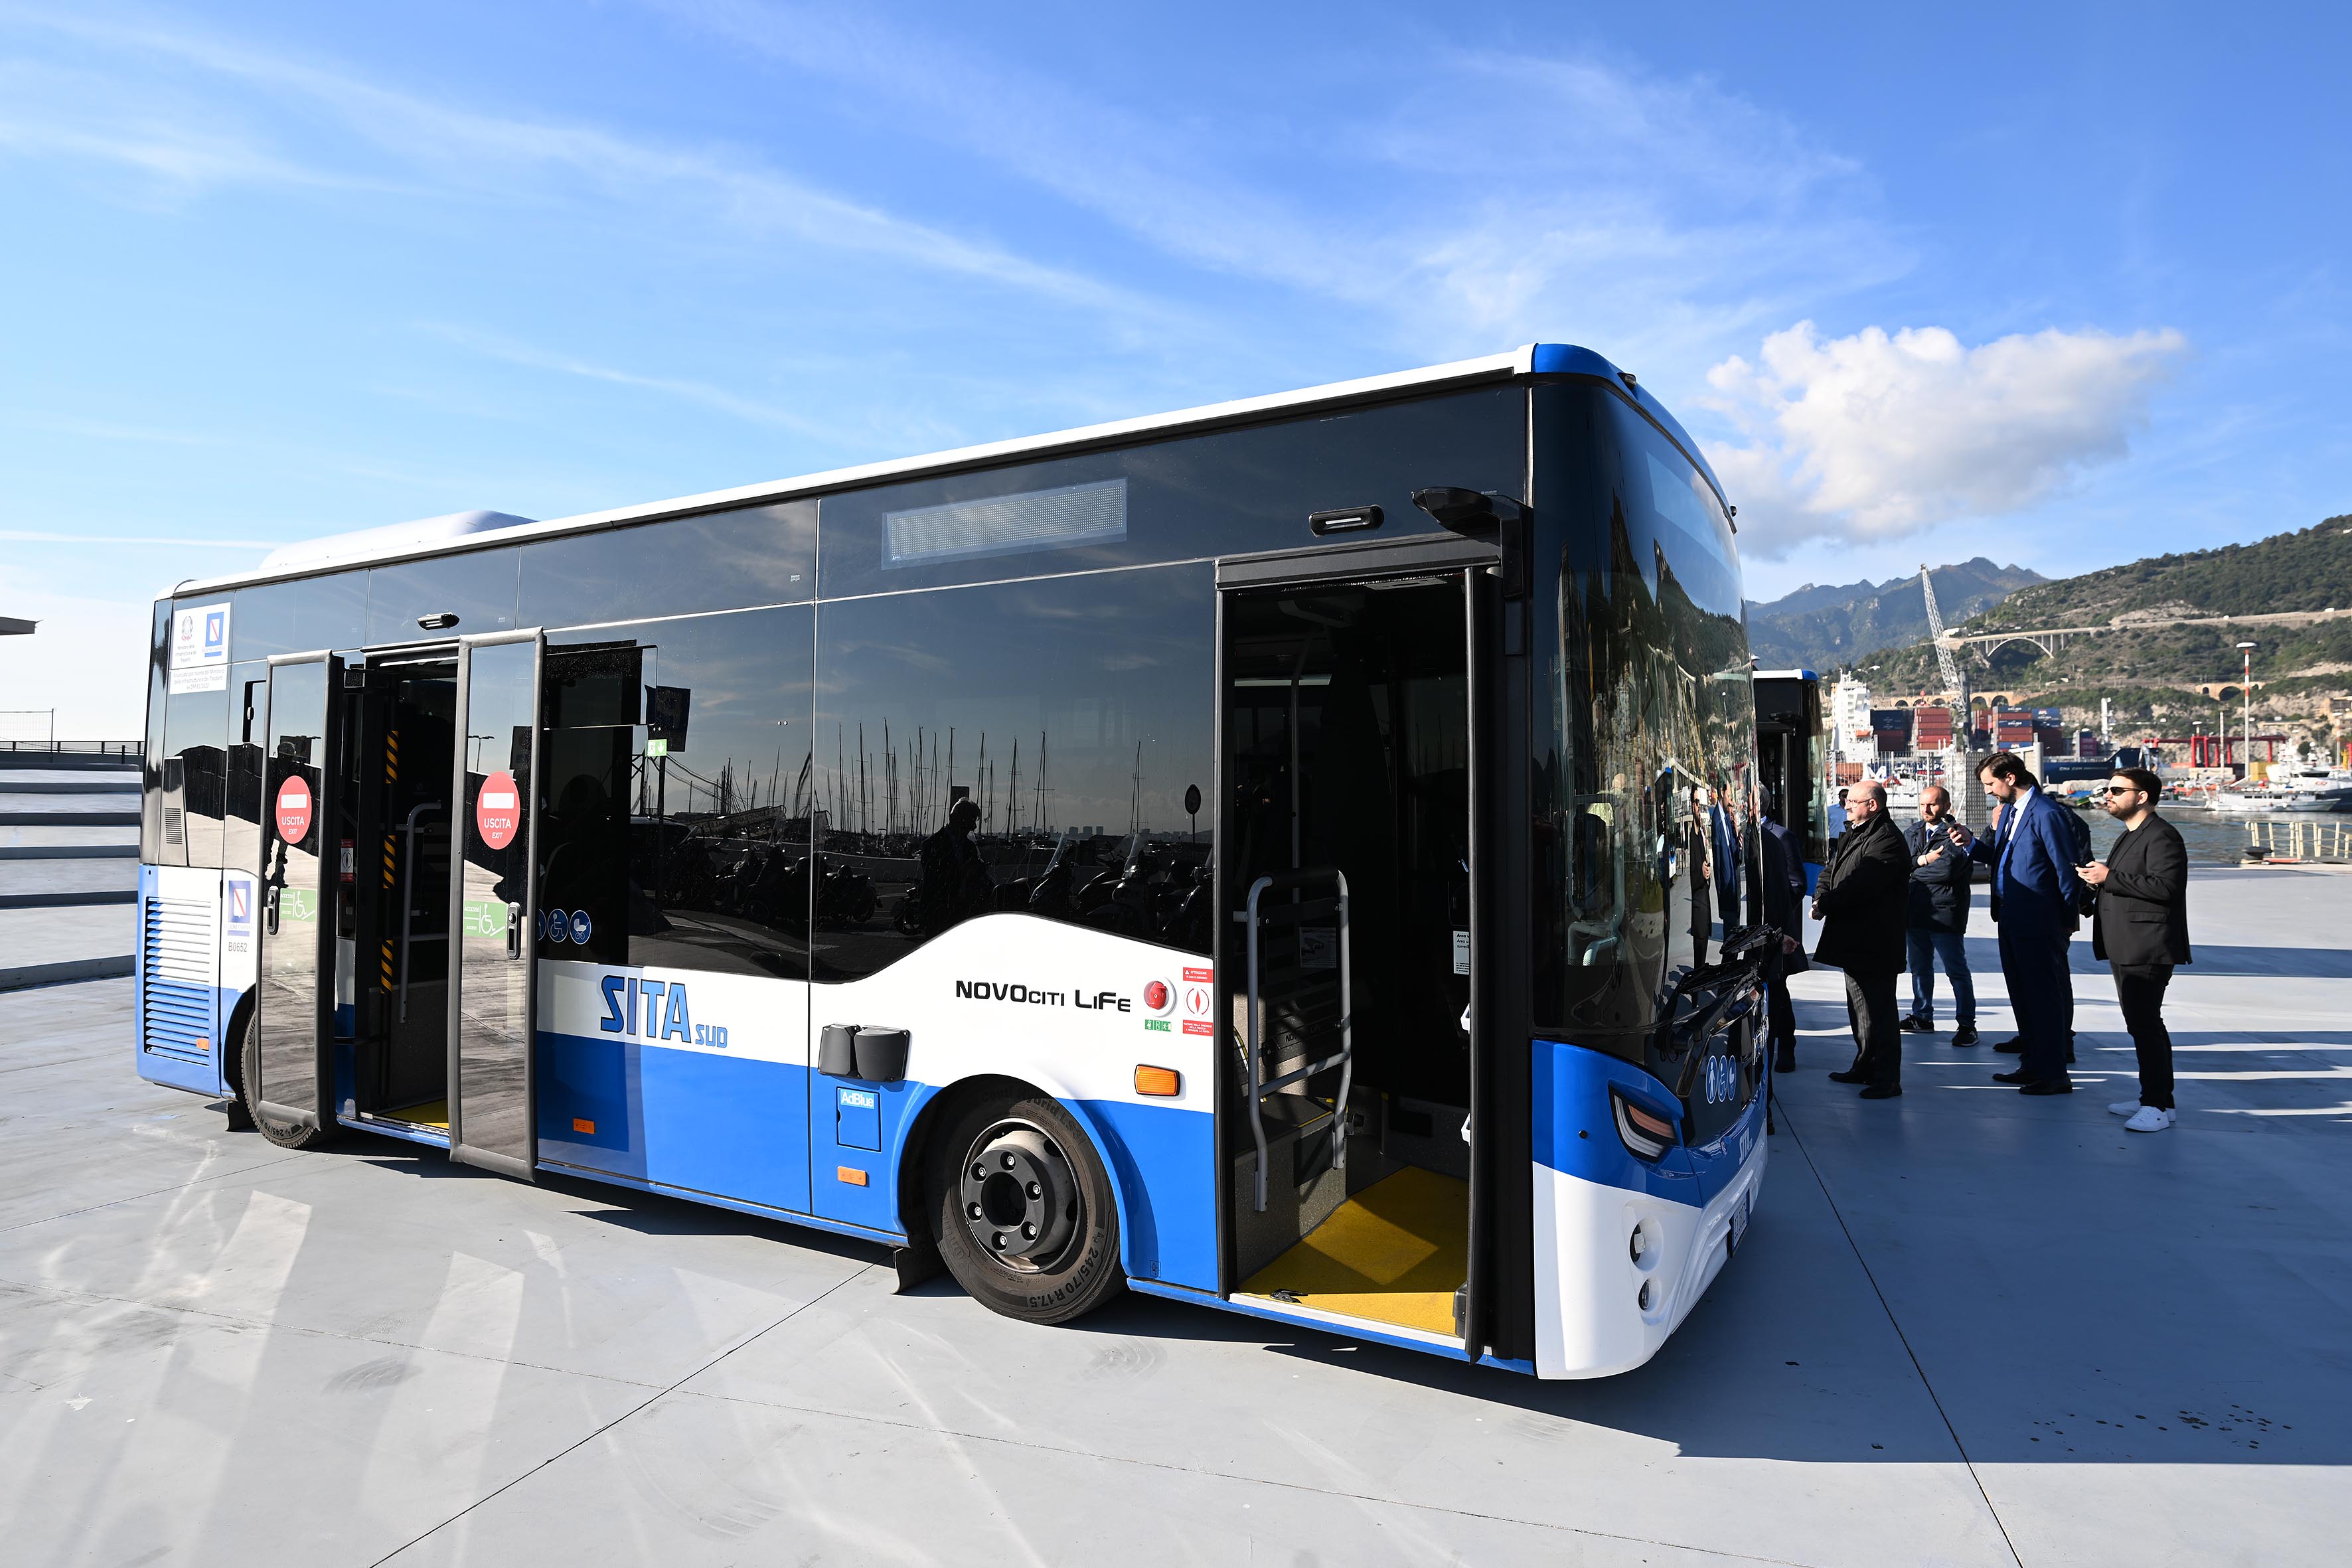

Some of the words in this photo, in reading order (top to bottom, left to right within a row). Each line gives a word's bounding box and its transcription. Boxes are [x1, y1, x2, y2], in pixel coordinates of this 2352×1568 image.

[281, 816, 305, 826] USCITA
[484, 817, 512, 829] USCITA
[228, 941, 248, 953] B0652
[600, 975, 692, 1044] SITA
[695, 1024, 728, 1048] SUD
[841, 1091, 874, 1107] AdBlue
[1065, 1247, 1099, 1294] 245/70
